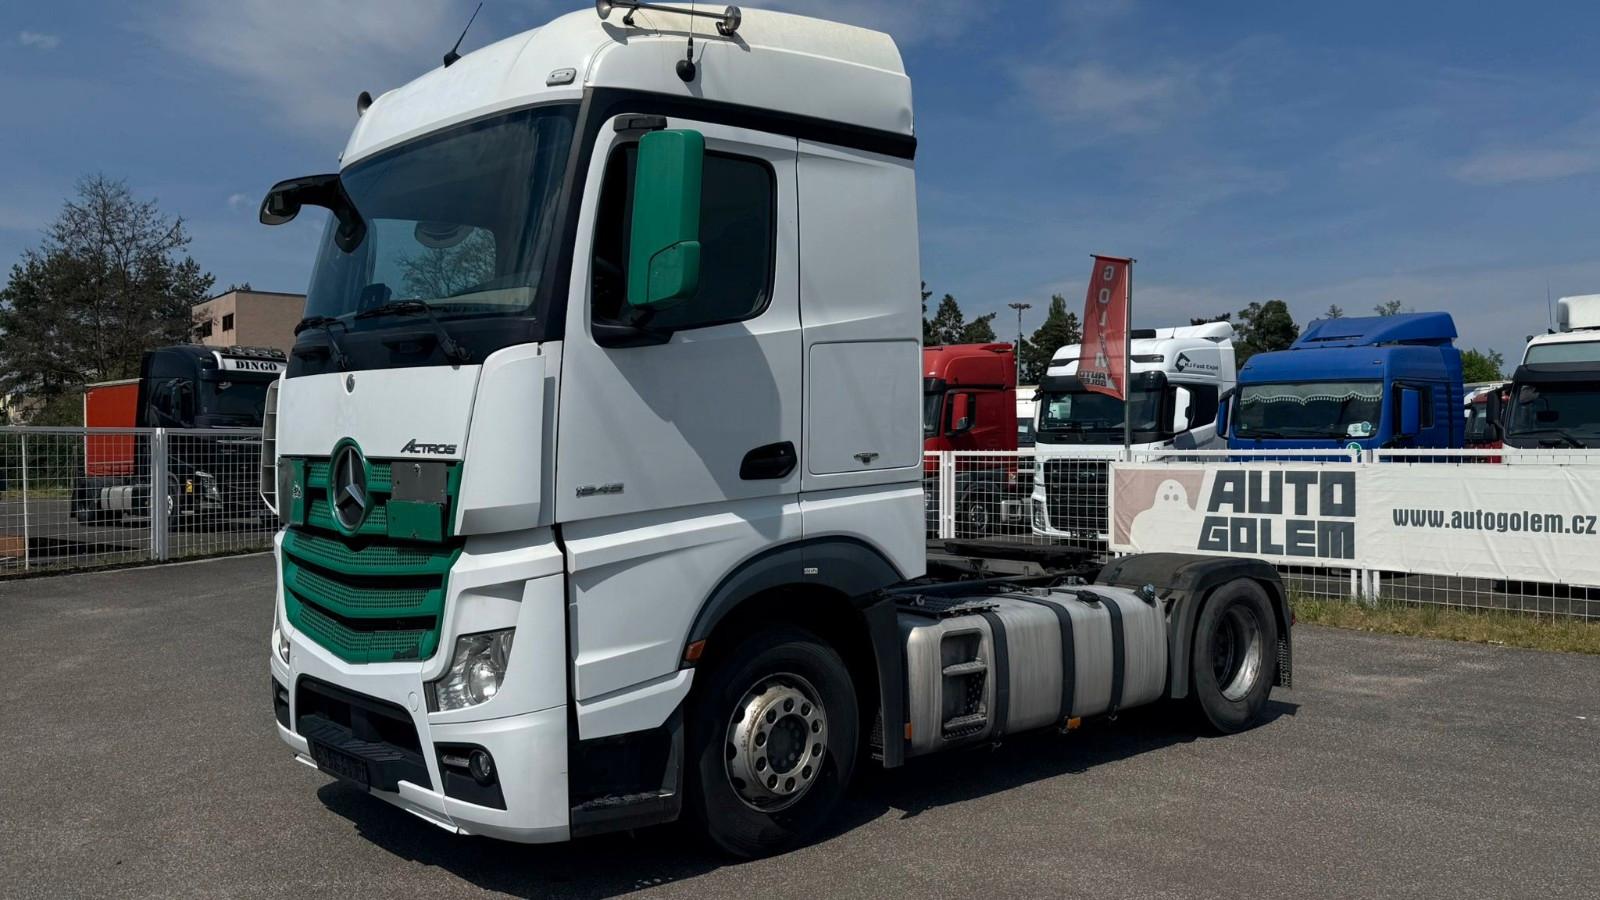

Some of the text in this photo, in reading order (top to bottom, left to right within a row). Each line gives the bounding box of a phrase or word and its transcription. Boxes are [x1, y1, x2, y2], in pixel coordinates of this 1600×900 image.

[235, 360, 277, 371] DINGO
[1207, 470, 1356, 517] AUTO
[1197, 516, 1355, 560] GOLEM
[1393, 508, 1597, 535] www.autogolem.cz
